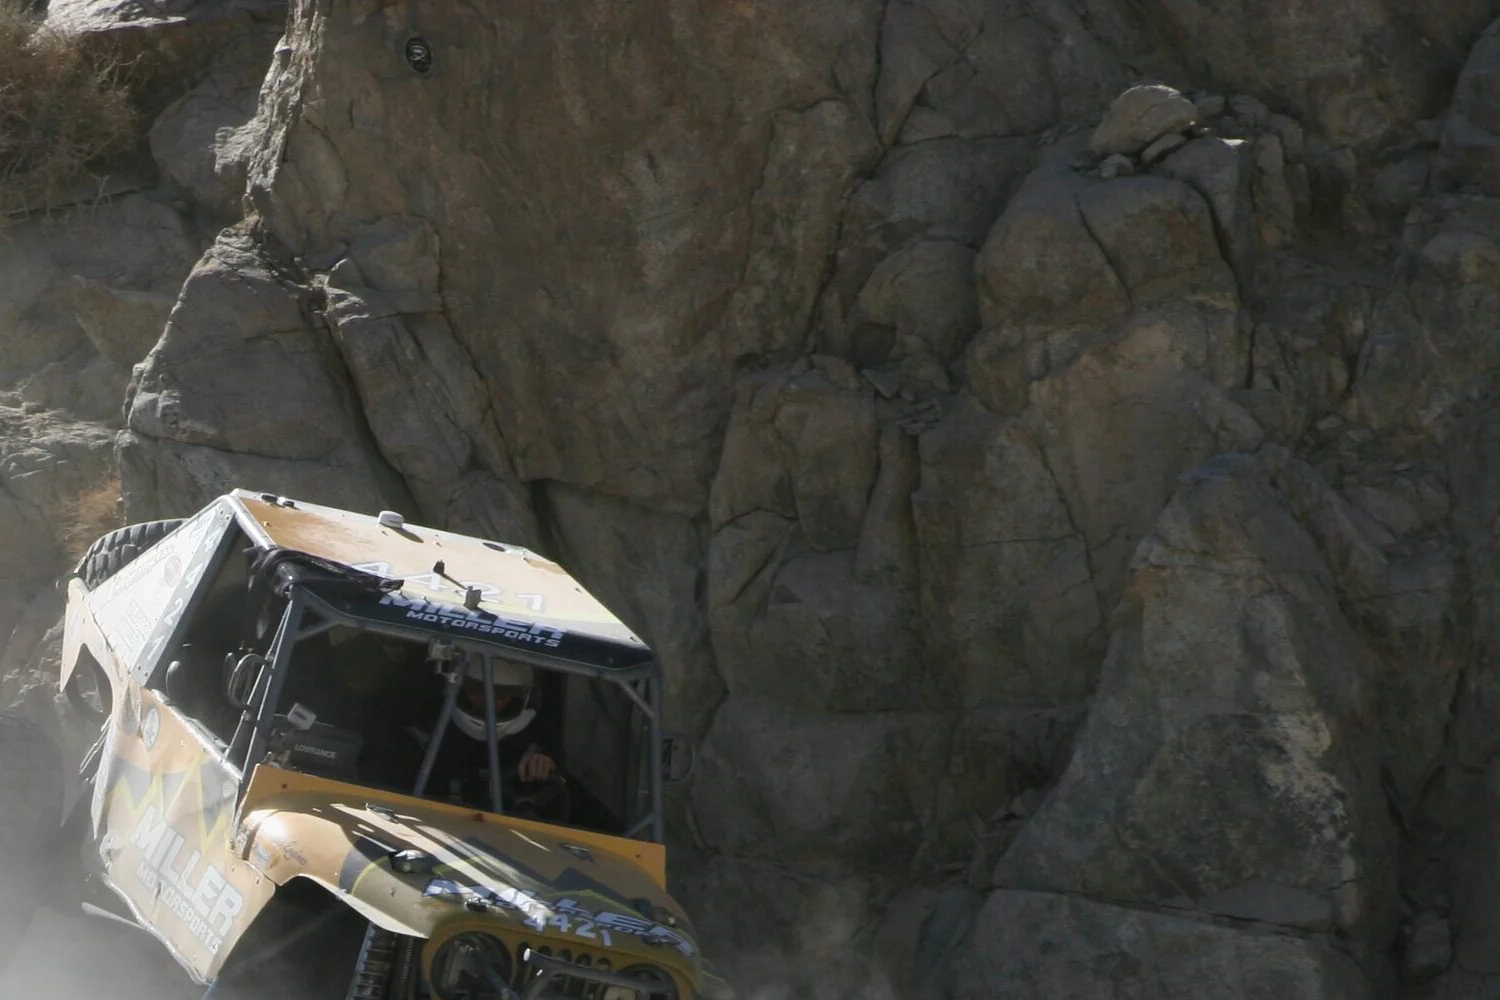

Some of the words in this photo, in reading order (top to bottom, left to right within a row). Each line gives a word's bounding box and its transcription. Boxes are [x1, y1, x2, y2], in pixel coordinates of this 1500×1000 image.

[379, 591, 567, 639] MILLER
[406, 610, 561, 648] MOTORSPORTS
[129, 806, 244, 937] MILLER
[136, 861, 223, 954] MOTORSPORTS
